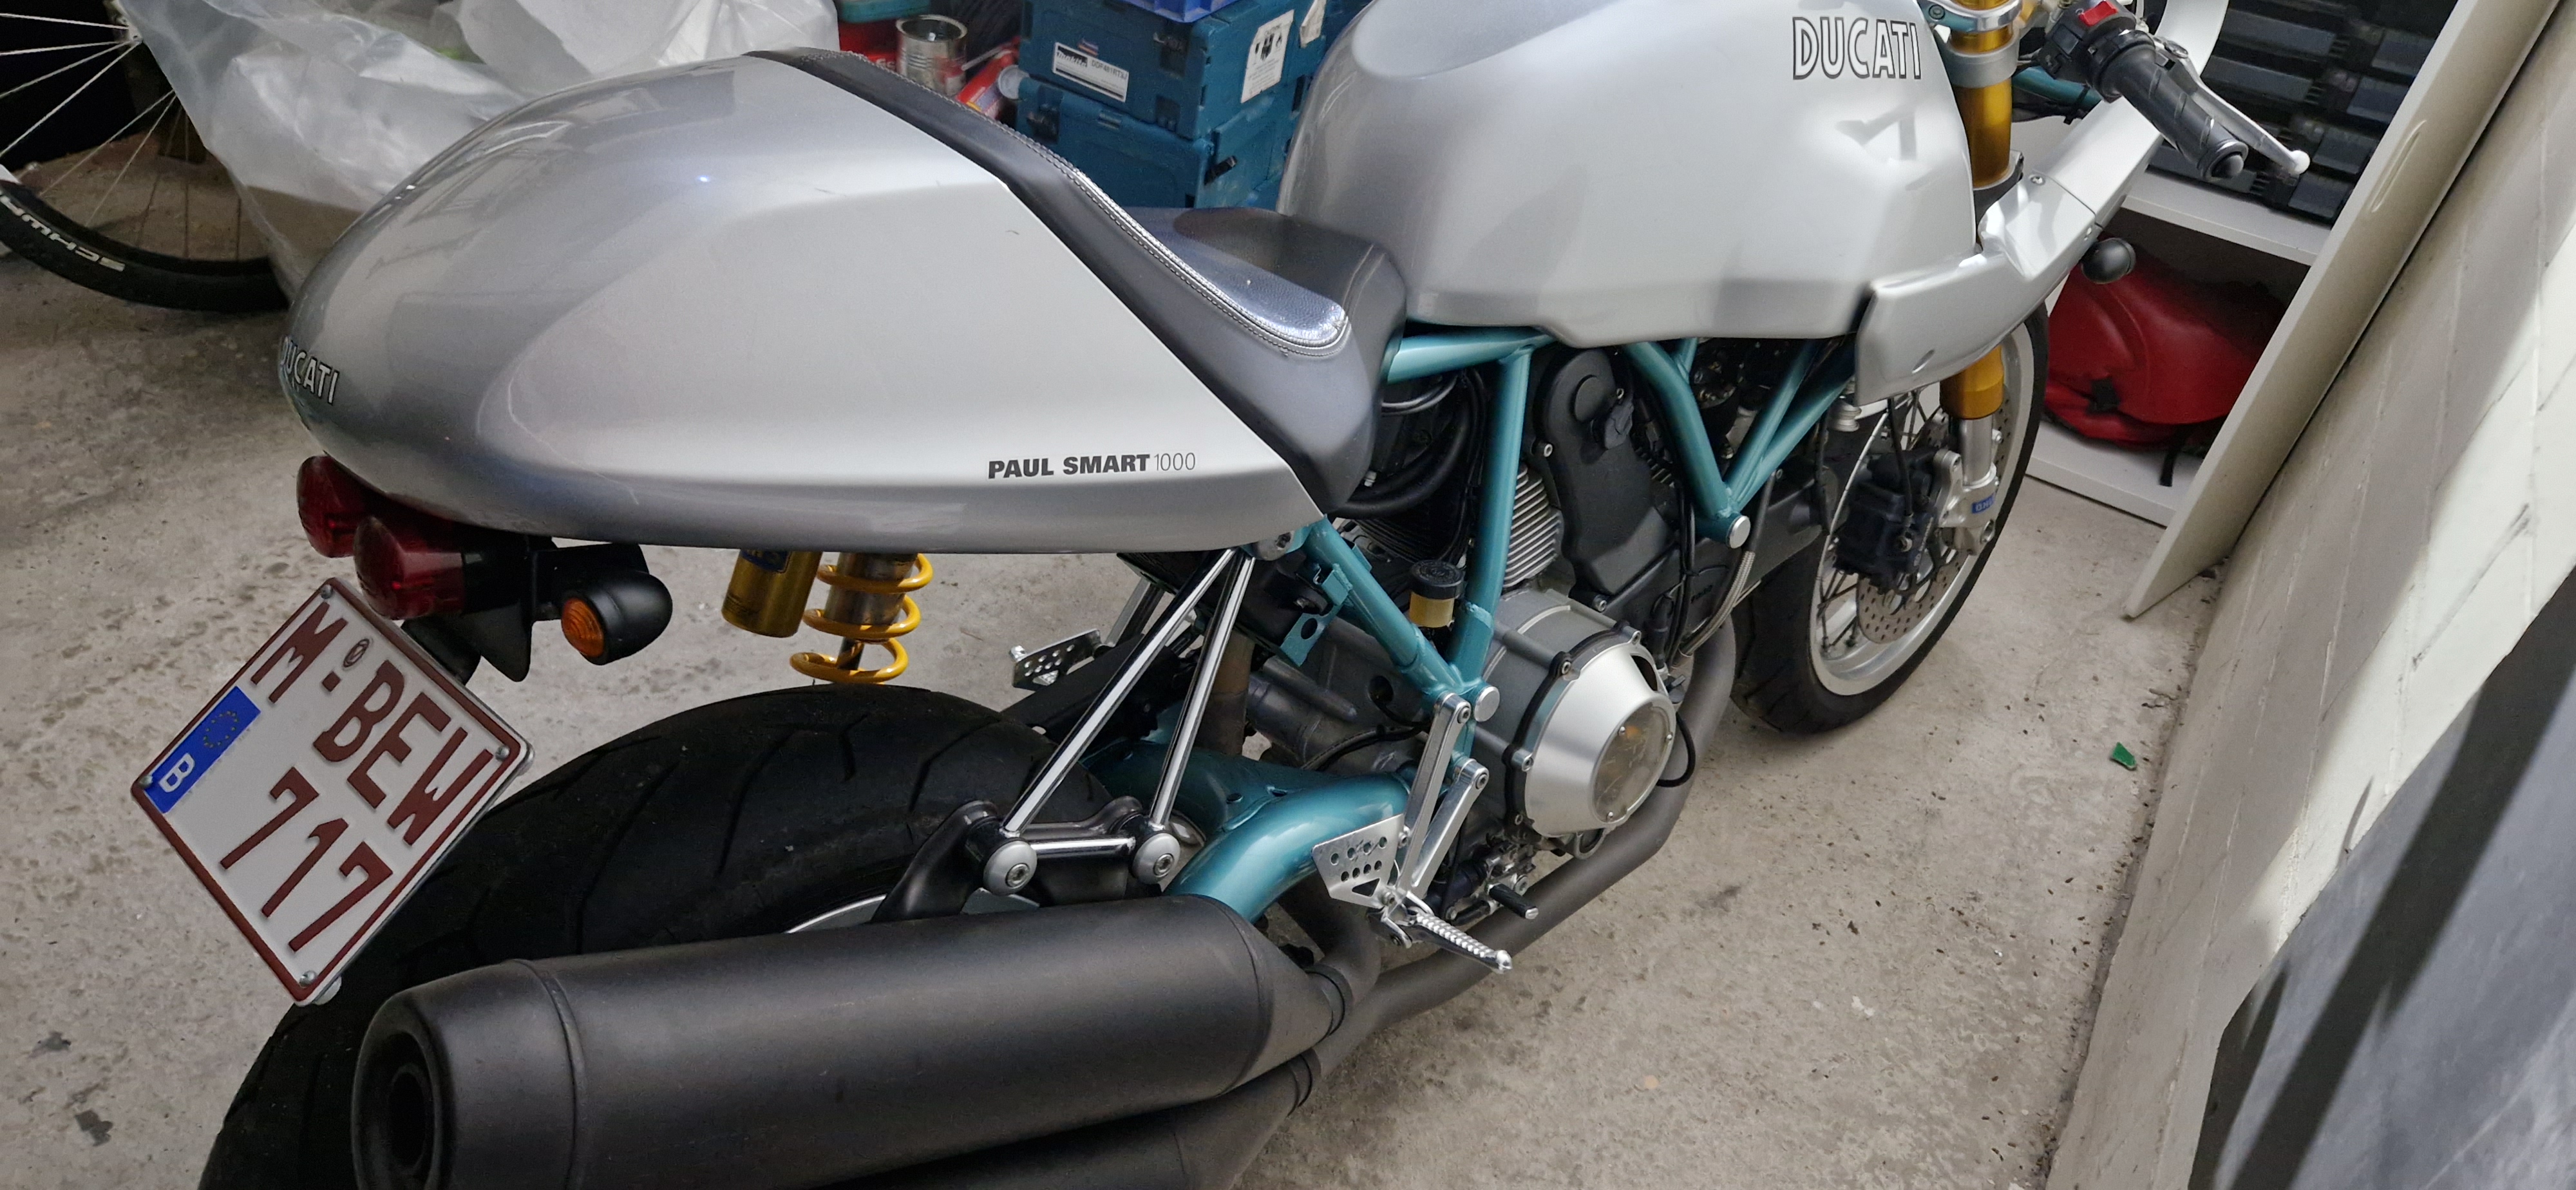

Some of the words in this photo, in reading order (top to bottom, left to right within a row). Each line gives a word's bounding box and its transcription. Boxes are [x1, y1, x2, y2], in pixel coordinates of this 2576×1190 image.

[1792, 16, 1921, 80] DUCATI
[0, 189, 126, 272] SCHWA
[988, 458, 1054, 479] PAUL
[1063, 454, 1150, 475] SMART
[1154, 452, 1196, 471] 1000
[158, 753, 194, 793] B
[220, 766, 393, 952] 717
